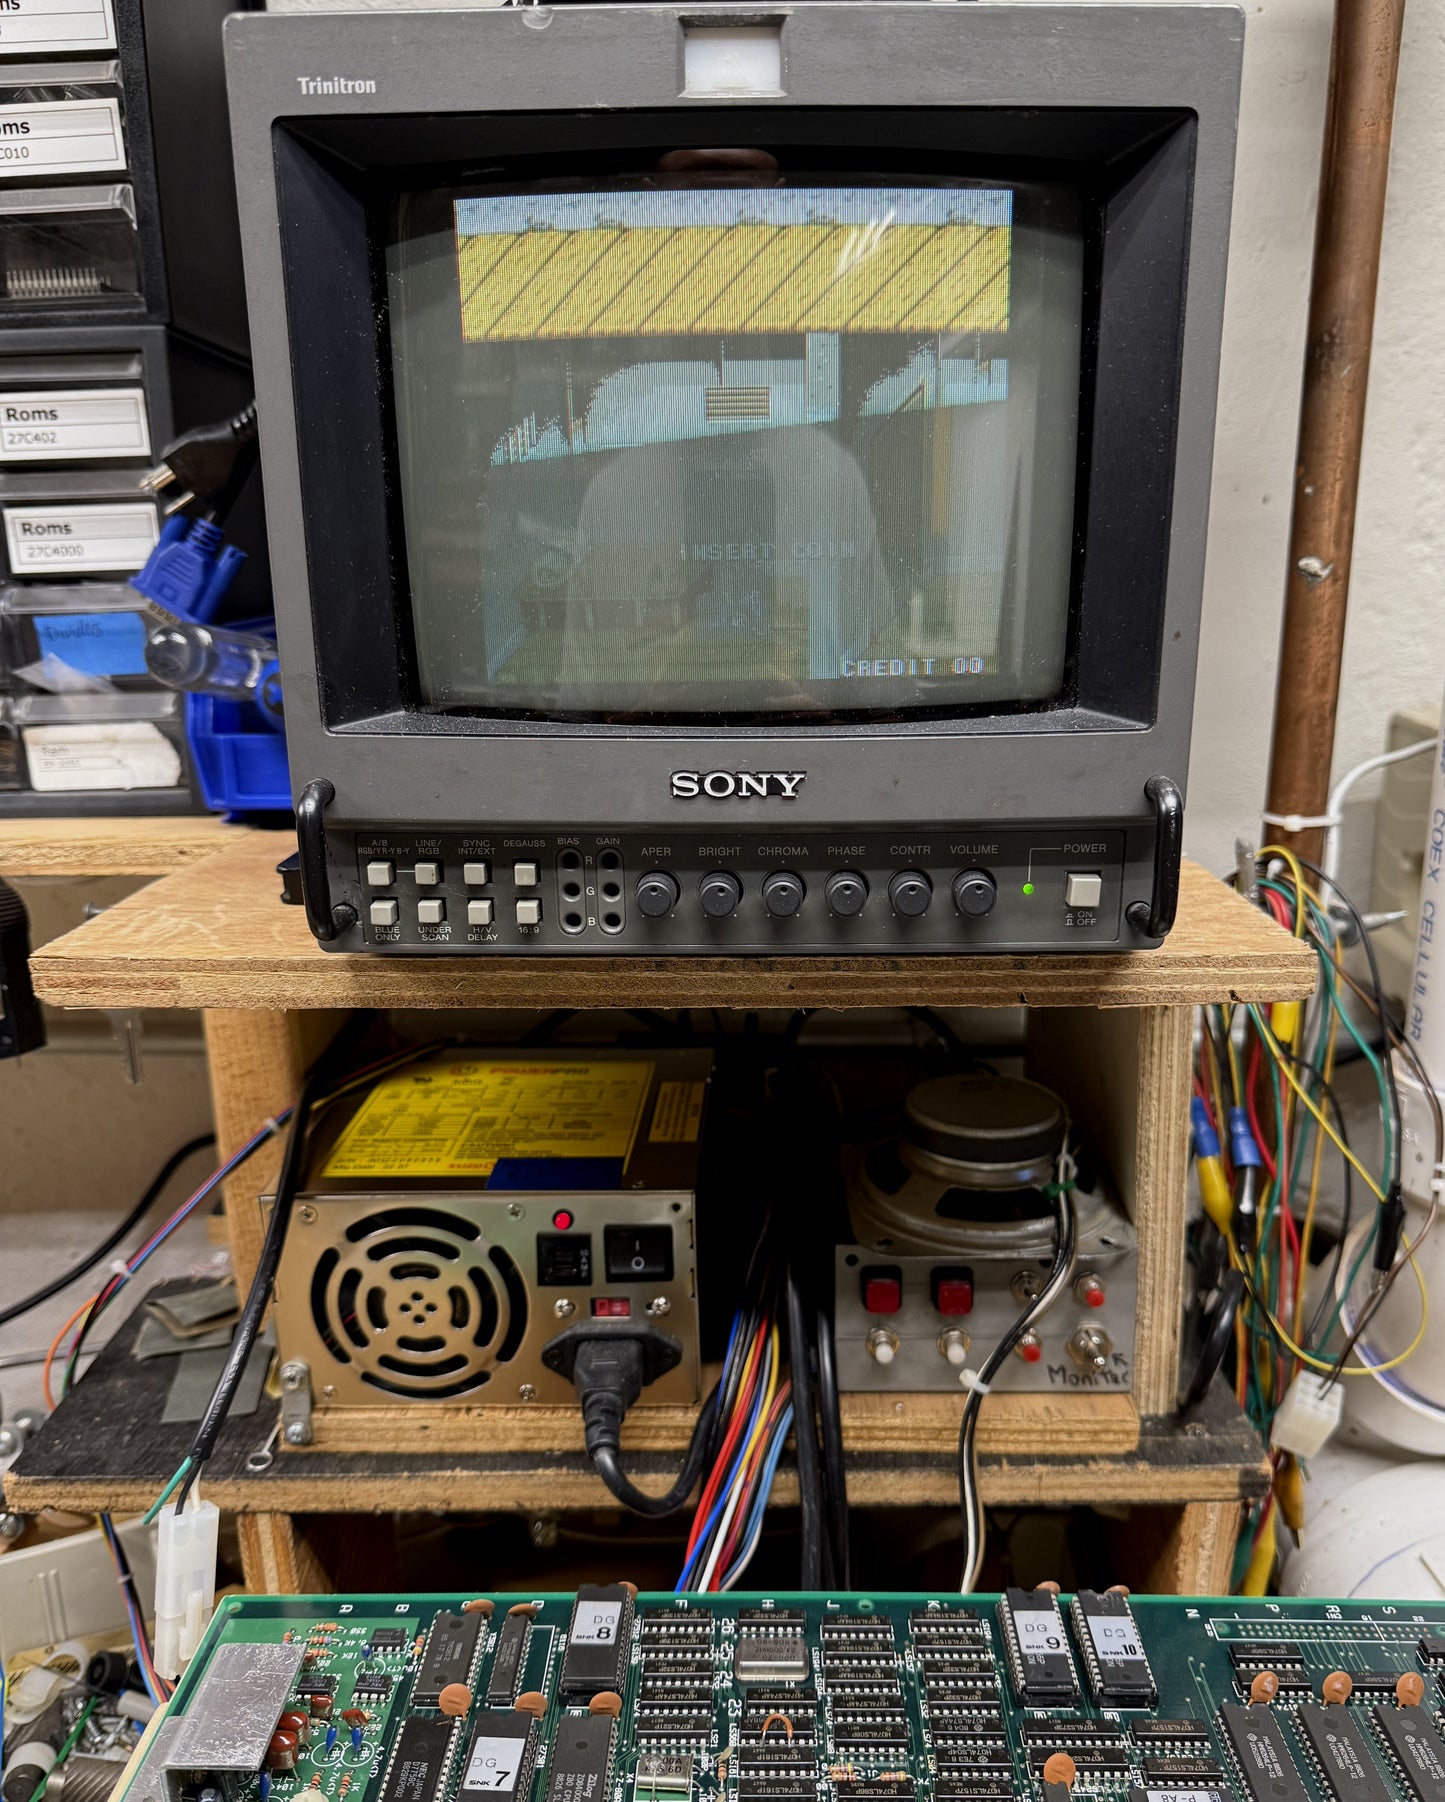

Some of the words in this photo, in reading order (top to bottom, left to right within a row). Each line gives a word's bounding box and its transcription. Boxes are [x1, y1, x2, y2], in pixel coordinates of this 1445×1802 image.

[297, 76, 377, 95] Trinitron
[6, 406, 59, 424] Roms
[22, 521, 73, 537] Roms
[679, 543, 776, 562] INSERT
[841, 657, 936, 678] CREDIT
[671, 772, 807, 798] SONY
[371, 839, 389, 848] A/B
[415, 839, 443, 848] LINE/
[462, 839, 491, 848] SYNC
[503, 839, 546, 849] DEGAUSS
[557, 837, 580, 846] BIAS
[596, 837, 621, 846] GAIN
[418, 847, 440, 856] RGB
[458, 847, 497, 856] INT/EXT
[640, 845, 672, 857] APER
[698, 845, 742, 857] BRIGHT
[757, 845, 809, 857] CHROMA
[827, 845, 866, 856] PHASE
[889, 844, 932, 856] CONTR
[949, 844, 998, 856] VOLUME
[1063, 842, 1107, 854] POWER
[585, 855, 594, 866] R
[586, 886, 596, 897] G
[1077, 910, 1094, 919] ON
[588, 917, 597, 927] B
[1077, 918, 1098, 928] OFF
[375, 926, 401, 934] BLUE
[418, 926, 453, 934] UNDER
[472, 926, 492, 935] H/V
[375, 933, 401, 942] ONLY
[422, 933, 450, 942] SCAN
[467, 933, 499, 942] DELAY
[674, 1599, 689, 1609] F
[761, 1599, 775, 1608] H
[826, 1599, 841, 1609] J
[927, 1600, 941, 1610] K
[720, 1617, 735, 1635] 26
[596, 1626, 612, 1640] 8
[1044, 1636, 1061, 1651] 9
[720, 1644, 735, 1661] 25
[1122, 1644, 1138, 1657] 10
[719, 1670, 734, 1688] 24
[727, 1698, 743, 1718] 23
[418, 1762, 429, 1779] NEC
[468, 1778, 491, 1787] SNK
[495, 1769, 512, 1788] 7
[411, 1779, 425, 1801] JAPAN
[582, 1773, 599, 1799] Zilog
